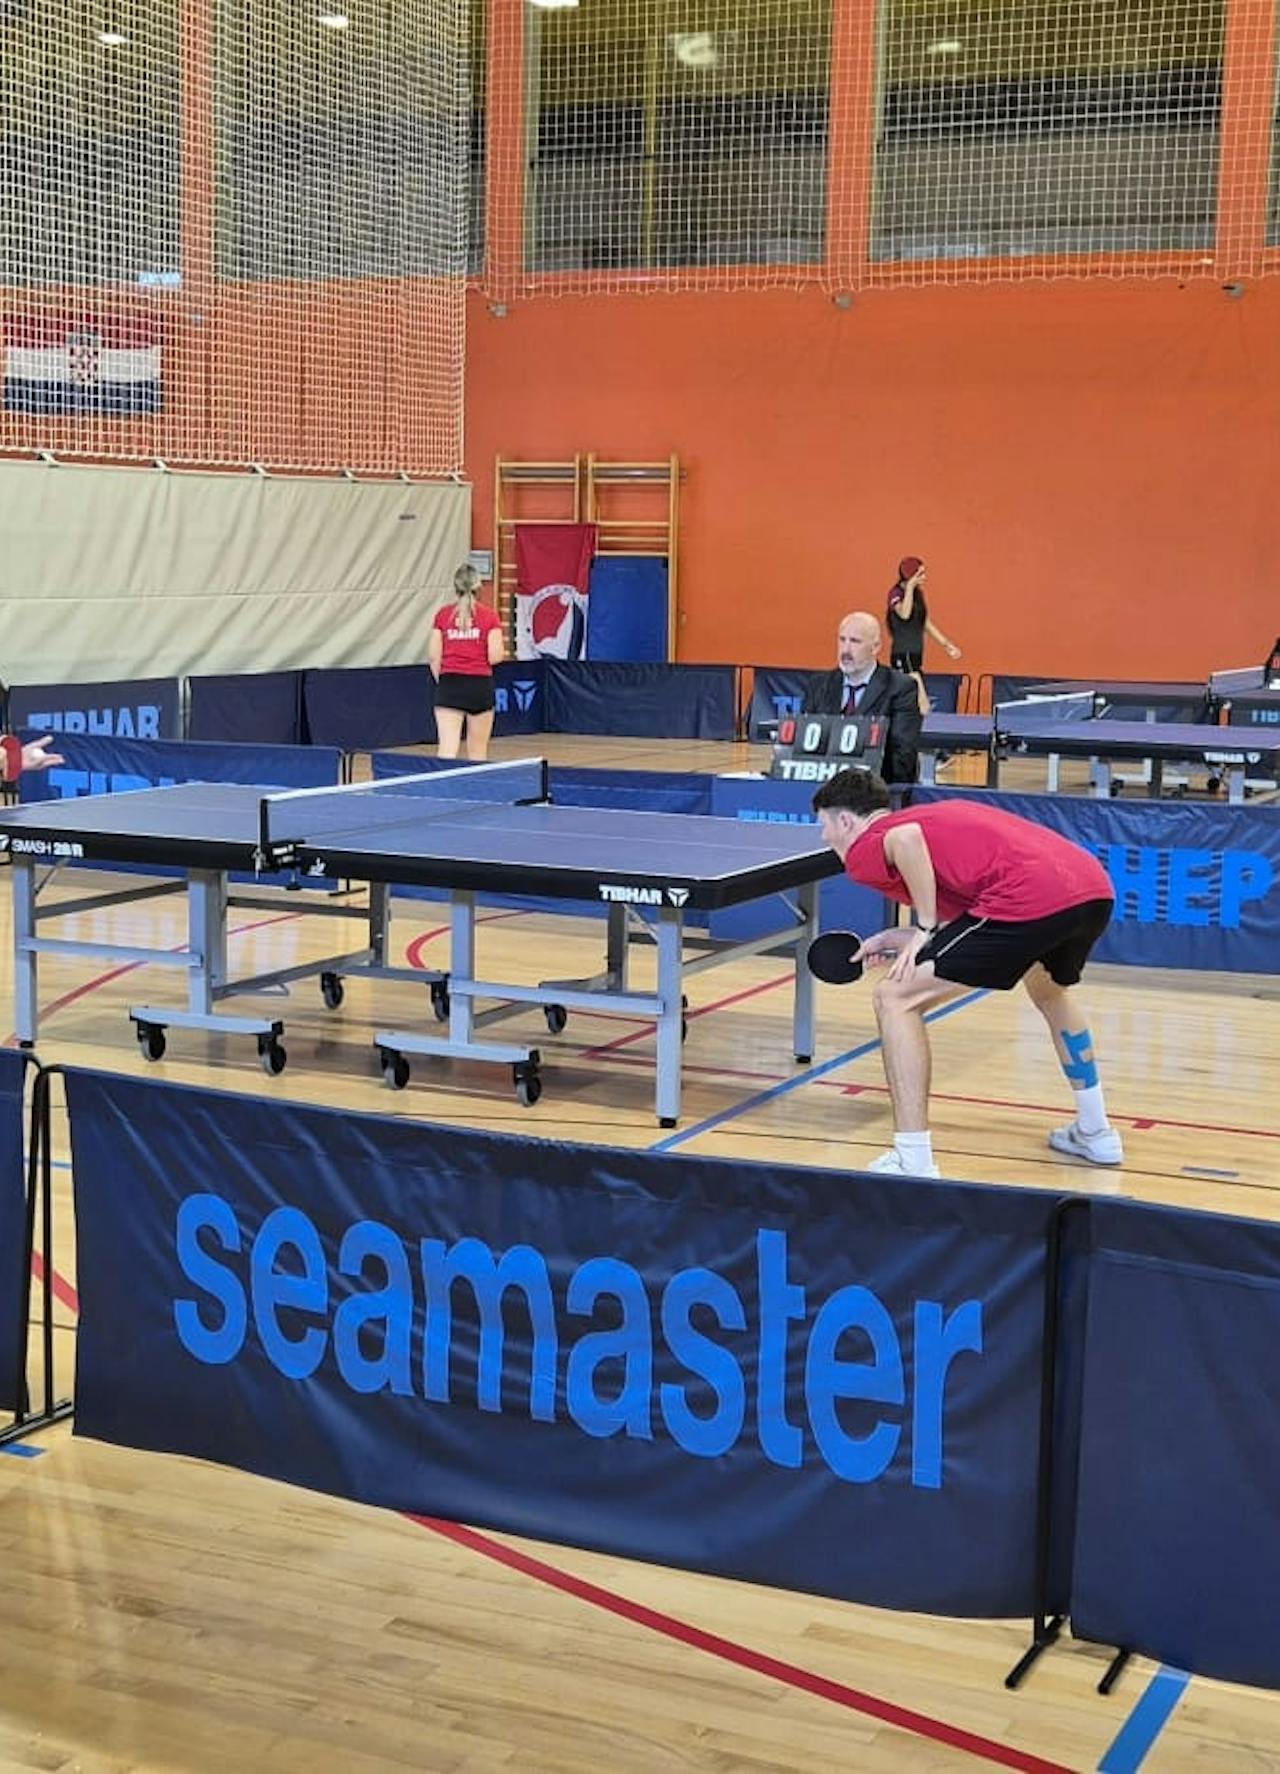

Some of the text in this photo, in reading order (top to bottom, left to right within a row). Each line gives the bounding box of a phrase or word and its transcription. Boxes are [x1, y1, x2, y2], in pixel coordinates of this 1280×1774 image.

[780, 720, 795, 744] 0
[803, 722, 822, 752] 0
[840, 724, 859, 753] 0
[780, 760, 872, 781] TIBH
[11, 838, 51, 855] SMASH
[599, 884, 663, 905] TIBHAR
[173, 1193, 983, 1490] seamaster
